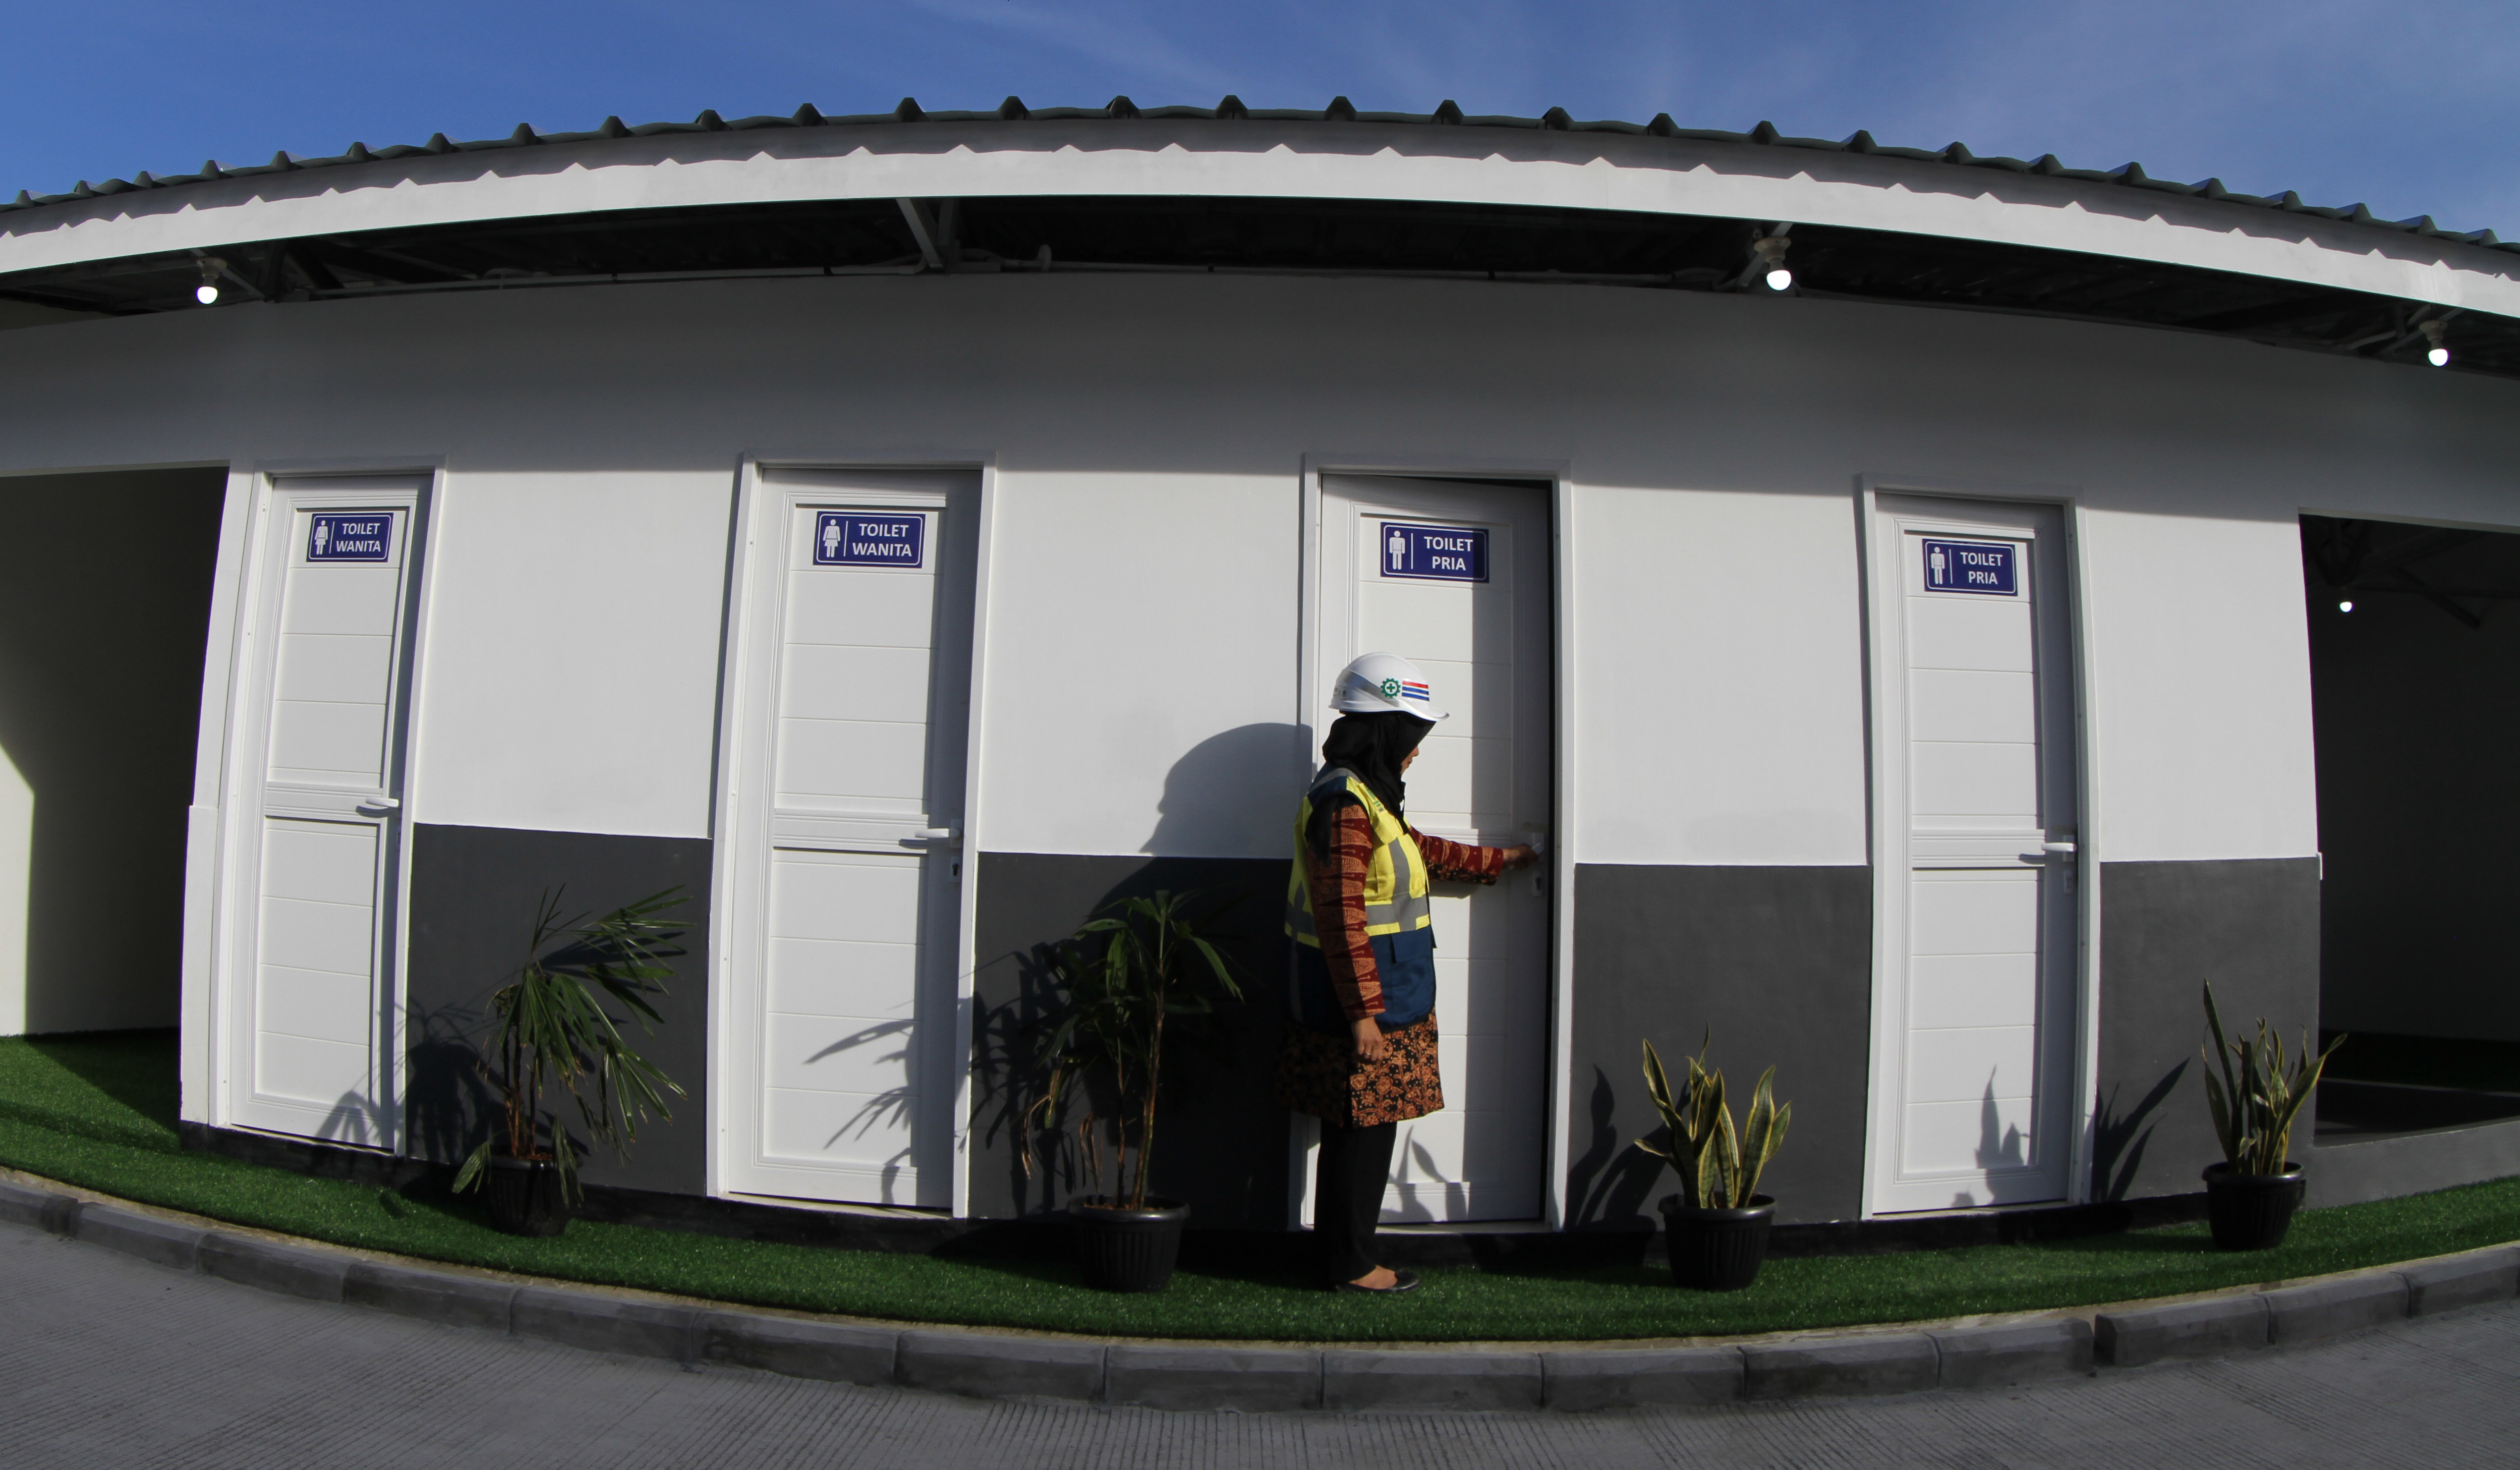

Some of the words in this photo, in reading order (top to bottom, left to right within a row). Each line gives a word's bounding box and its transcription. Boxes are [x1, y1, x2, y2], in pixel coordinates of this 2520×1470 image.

[342, 523, 380, 535] TOILET
[859, 524, 909, 537] TOILET
[336, 541, 381, 552] WANITA
[852, 543, 912, 556] WANITA
[1424, 536, 1473, 551] TOILET
[1432, 556, 1466, 571] PRIA
[1960, 552, 2002, 566] TOILET
[1968, 571, 1998, 585] PRIA
